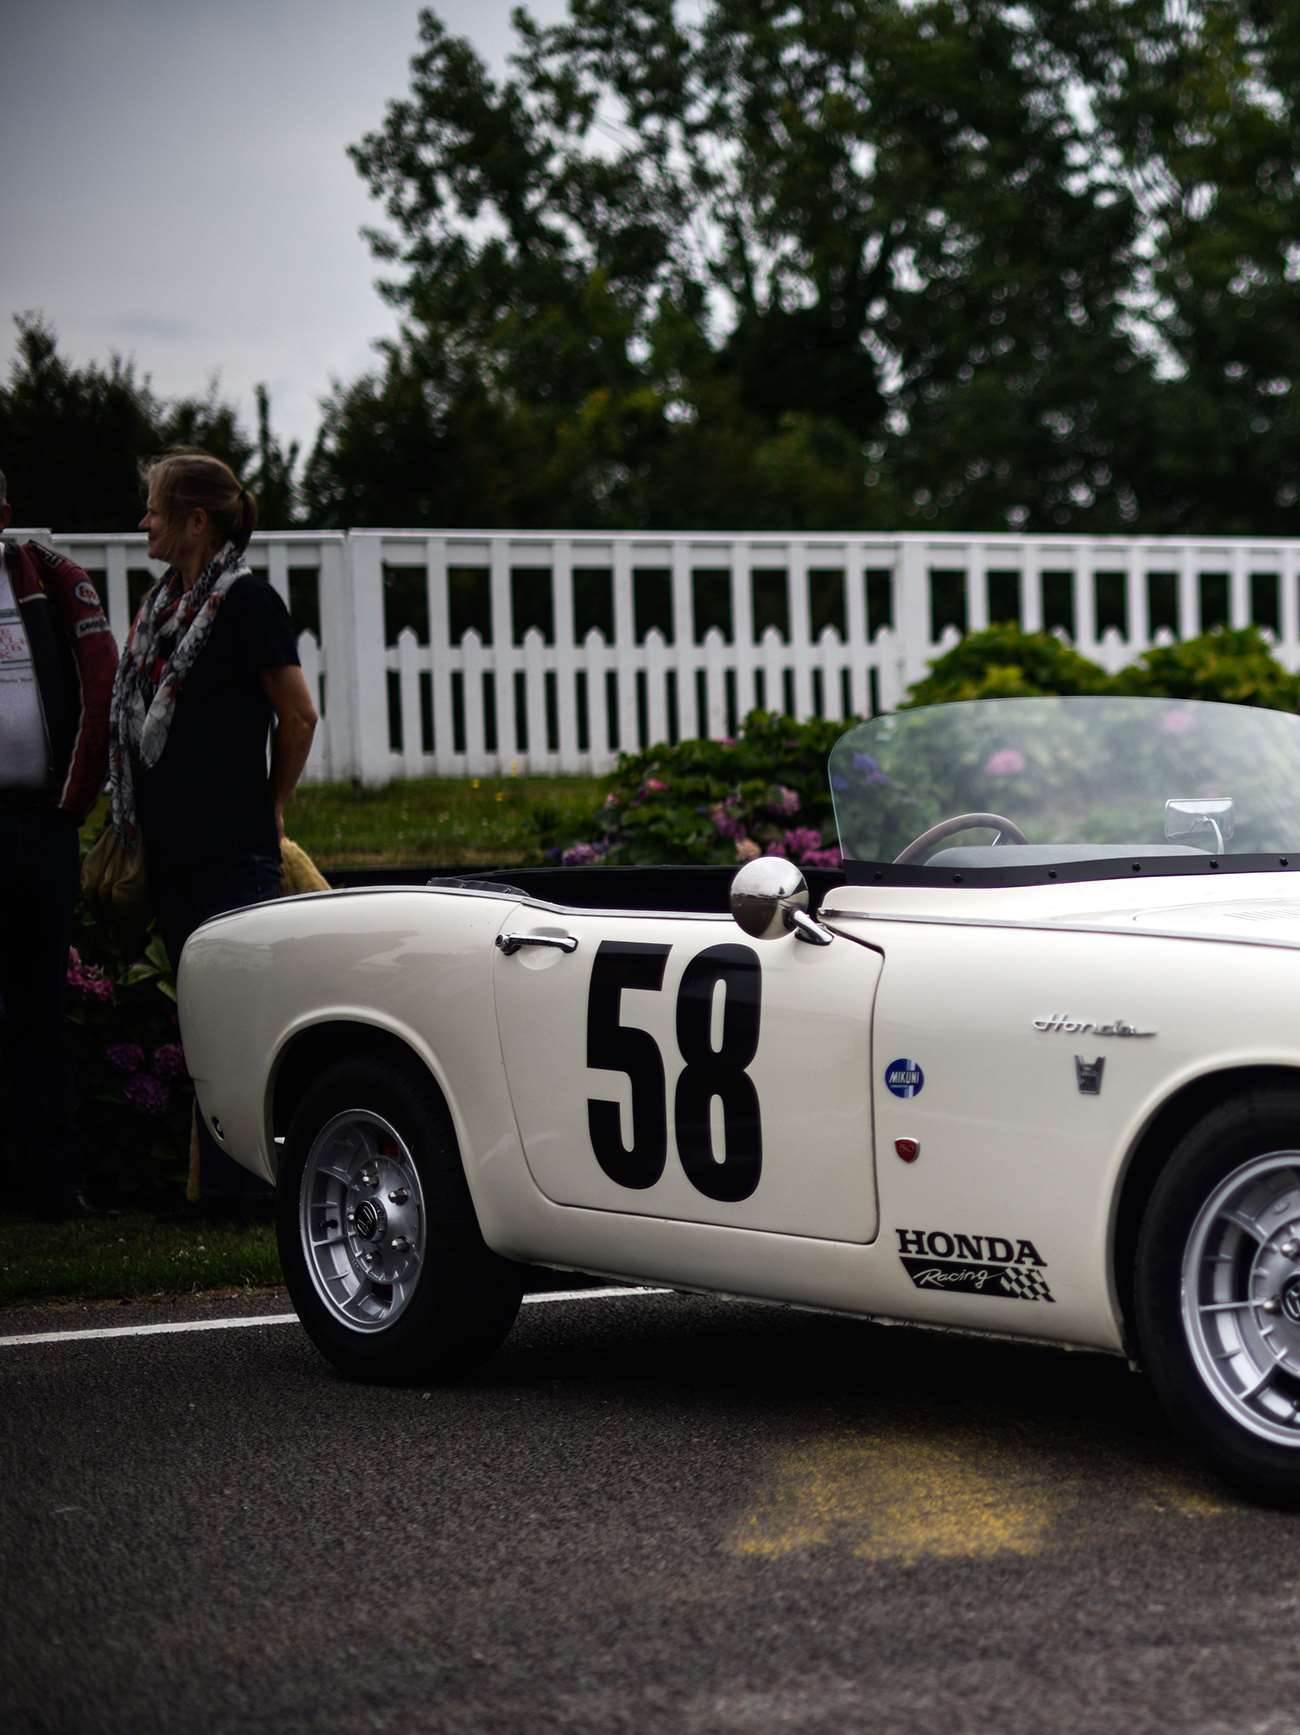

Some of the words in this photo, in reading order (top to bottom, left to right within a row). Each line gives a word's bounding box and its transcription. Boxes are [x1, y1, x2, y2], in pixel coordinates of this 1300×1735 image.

[1033, 1014, 1157, 1038] Honda
[587, 940, 762, 1203] 58
[888, 1071, 920, 1084] MIKUNI
[896, 1229, 1048, 1267] HONDA
[913, 1268, 1003, 1289] Racing
